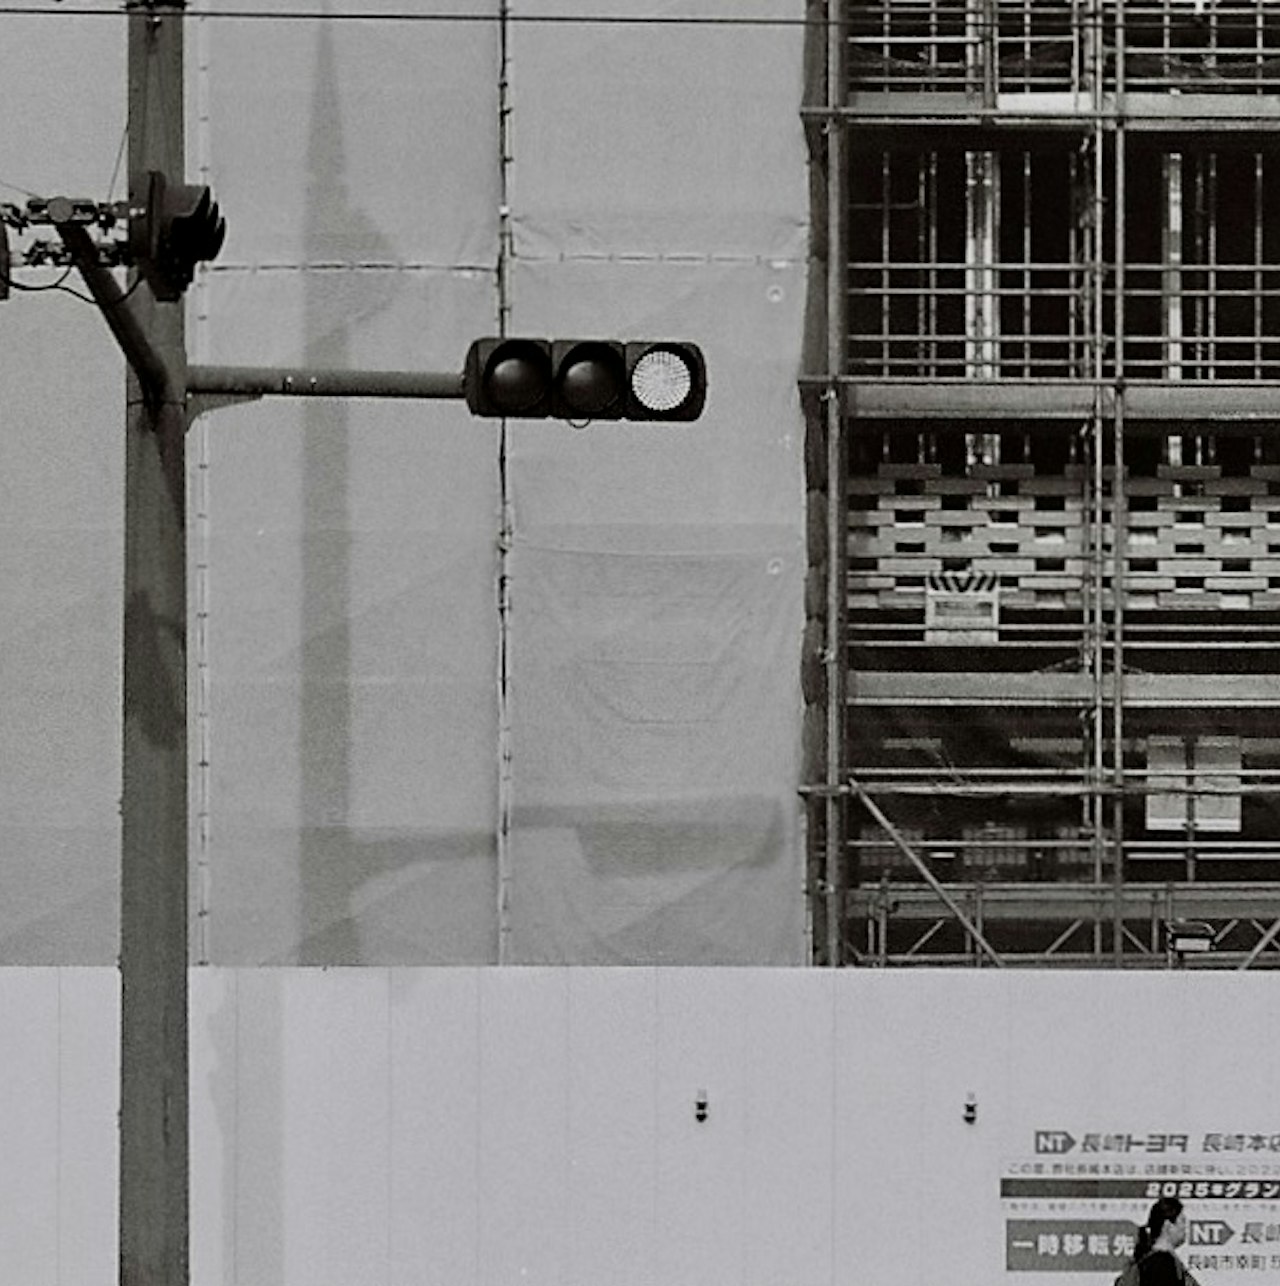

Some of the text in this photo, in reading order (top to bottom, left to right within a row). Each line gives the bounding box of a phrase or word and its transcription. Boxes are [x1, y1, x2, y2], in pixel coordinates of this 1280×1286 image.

[1080, 1133, 1188, 1153] 長崎トヨタ
[1012, 1233, 1136, 1257] 一時移転先
